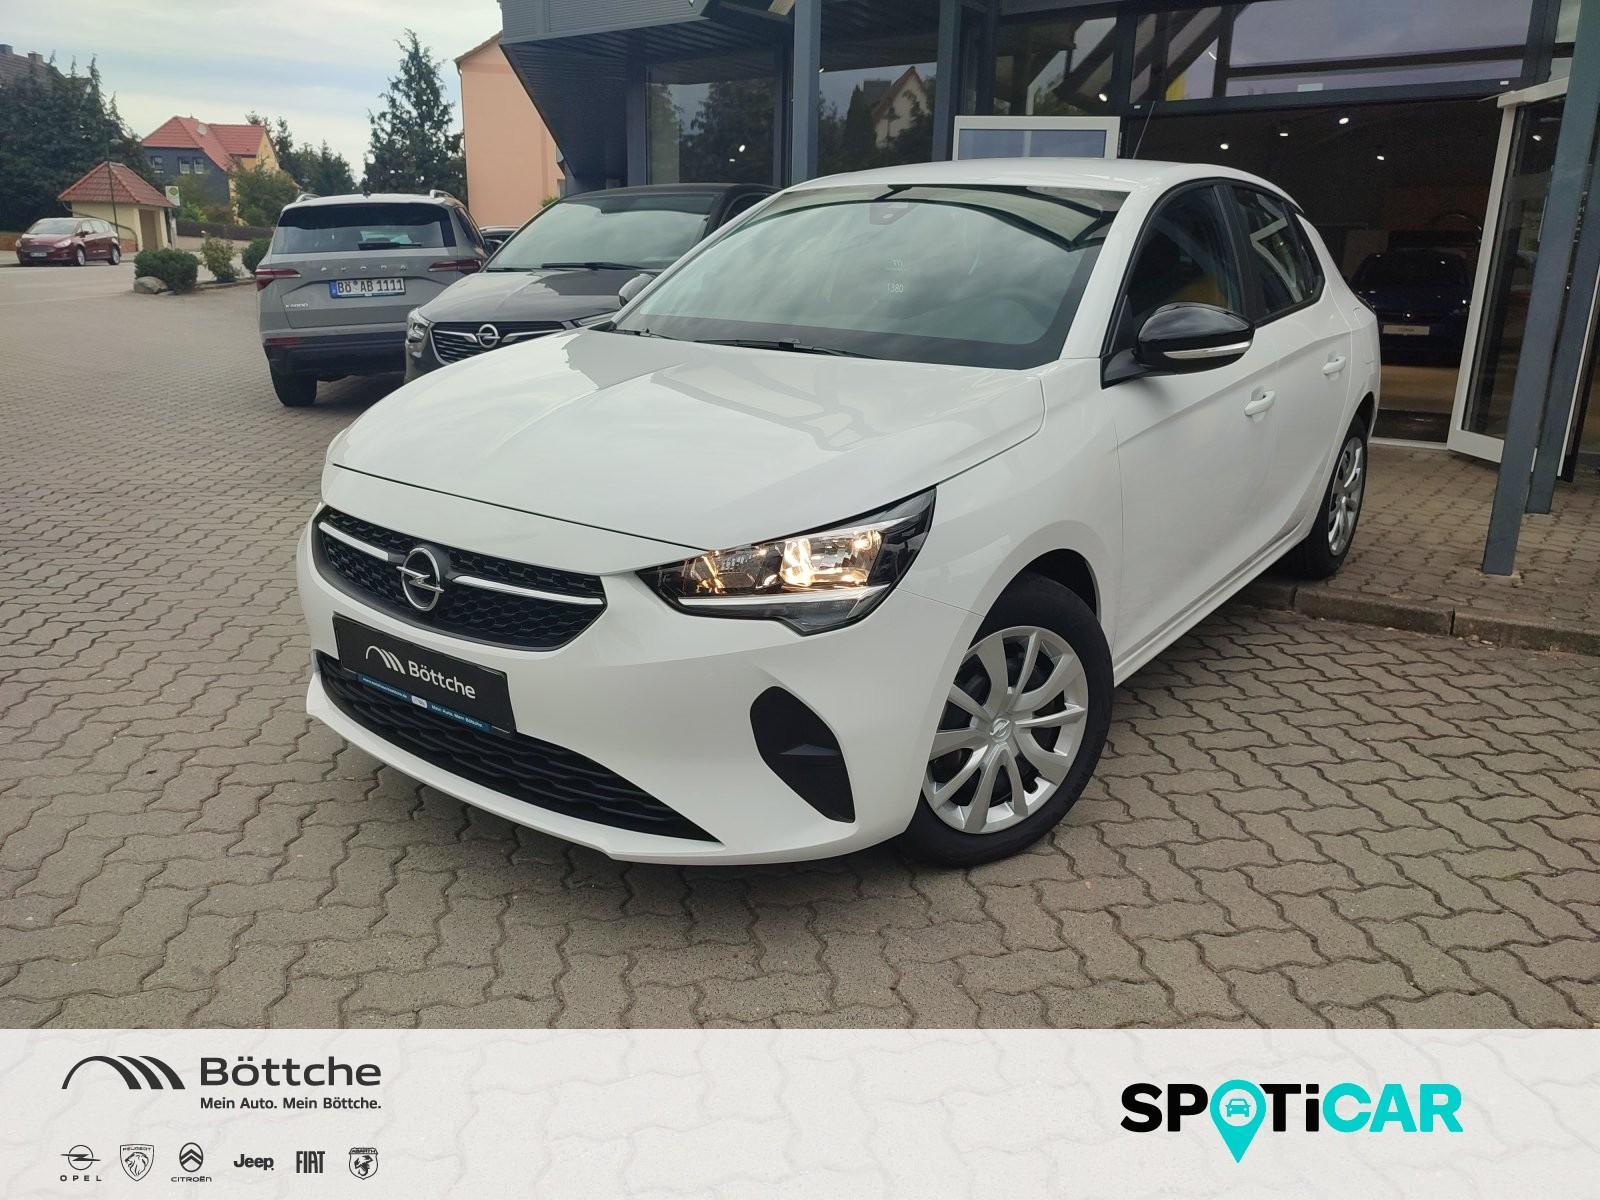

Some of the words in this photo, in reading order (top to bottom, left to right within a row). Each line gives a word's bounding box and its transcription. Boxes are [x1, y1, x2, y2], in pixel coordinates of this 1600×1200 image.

[360, 280, 374, 292] AB
[377, 279, 403, 292] 1111
[408, 659, 476, 700] Böttche
